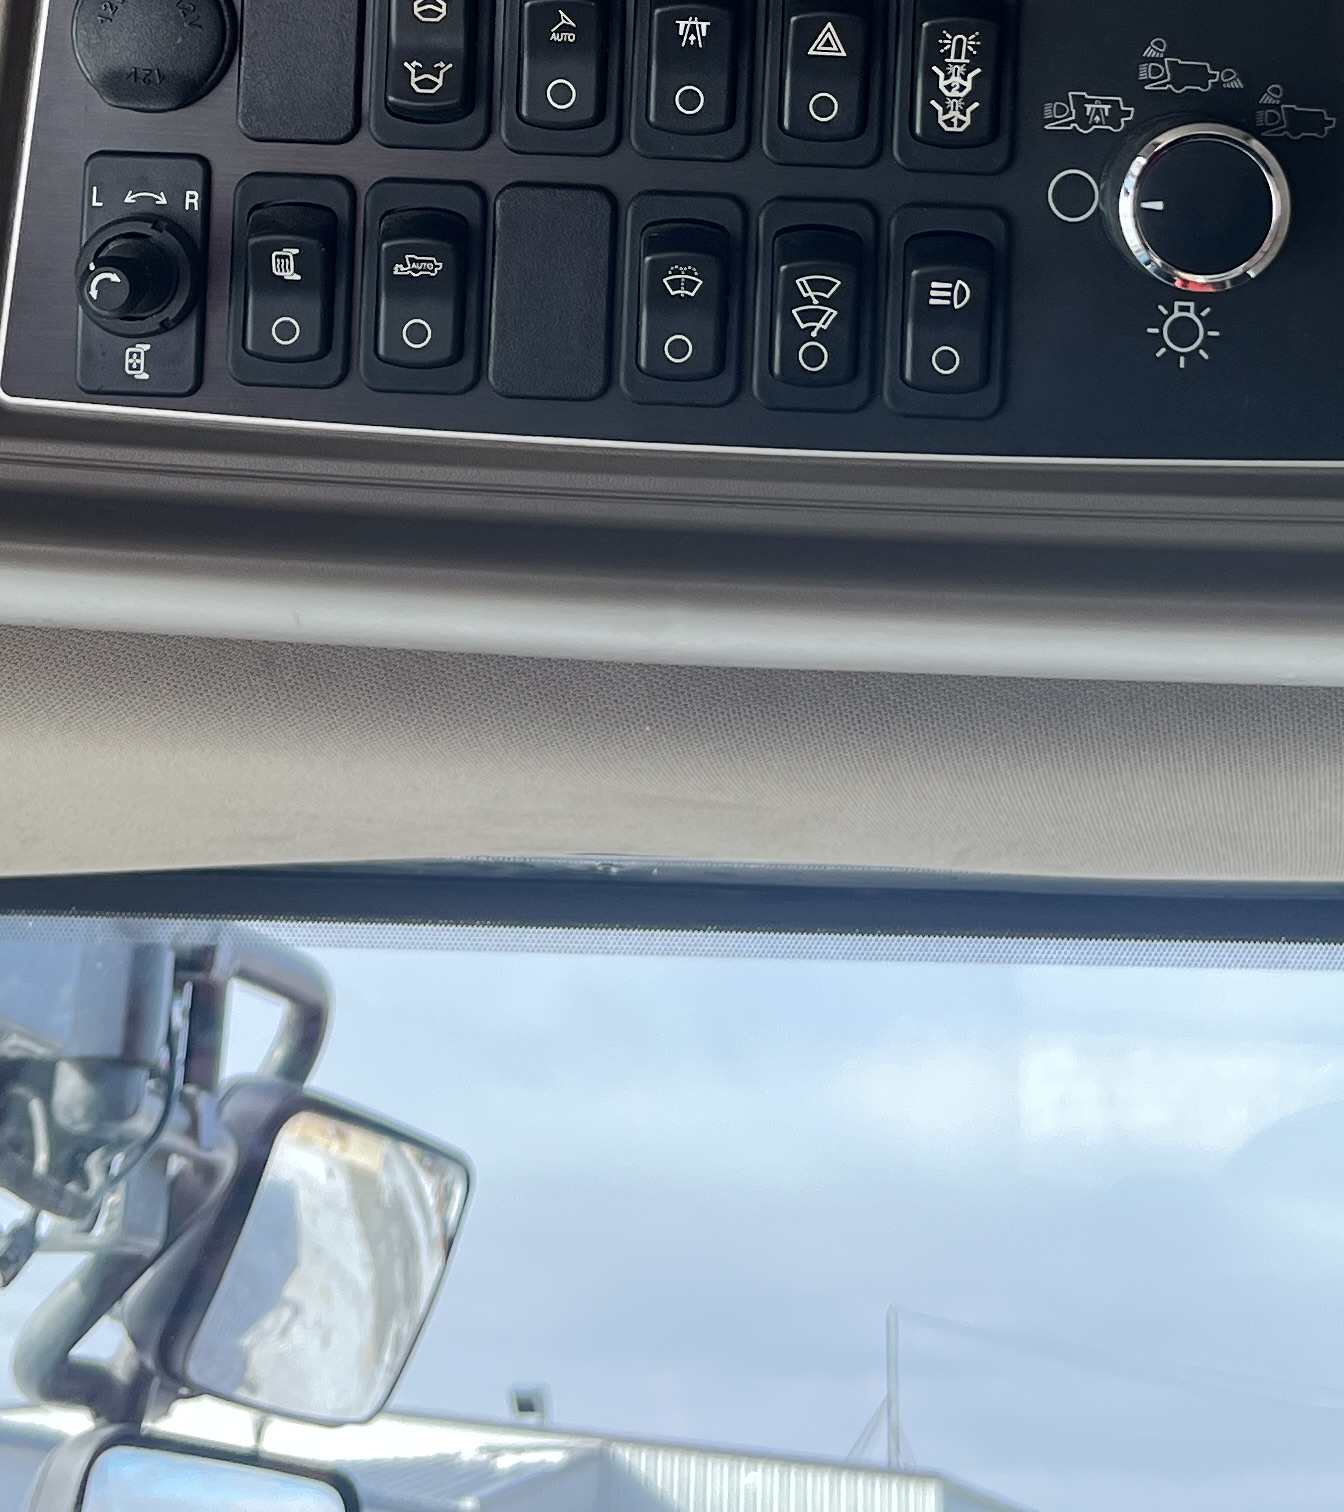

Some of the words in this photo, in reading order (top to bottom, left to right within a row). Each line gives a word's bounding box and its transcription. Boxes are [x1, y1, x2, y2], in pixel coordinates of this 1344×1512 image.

[549, 32, 576, 43] AUTO
[91, 185, 104, 207] L
[184, 190, 199, 211] R
[411, 262, 434, 271] AUTO
